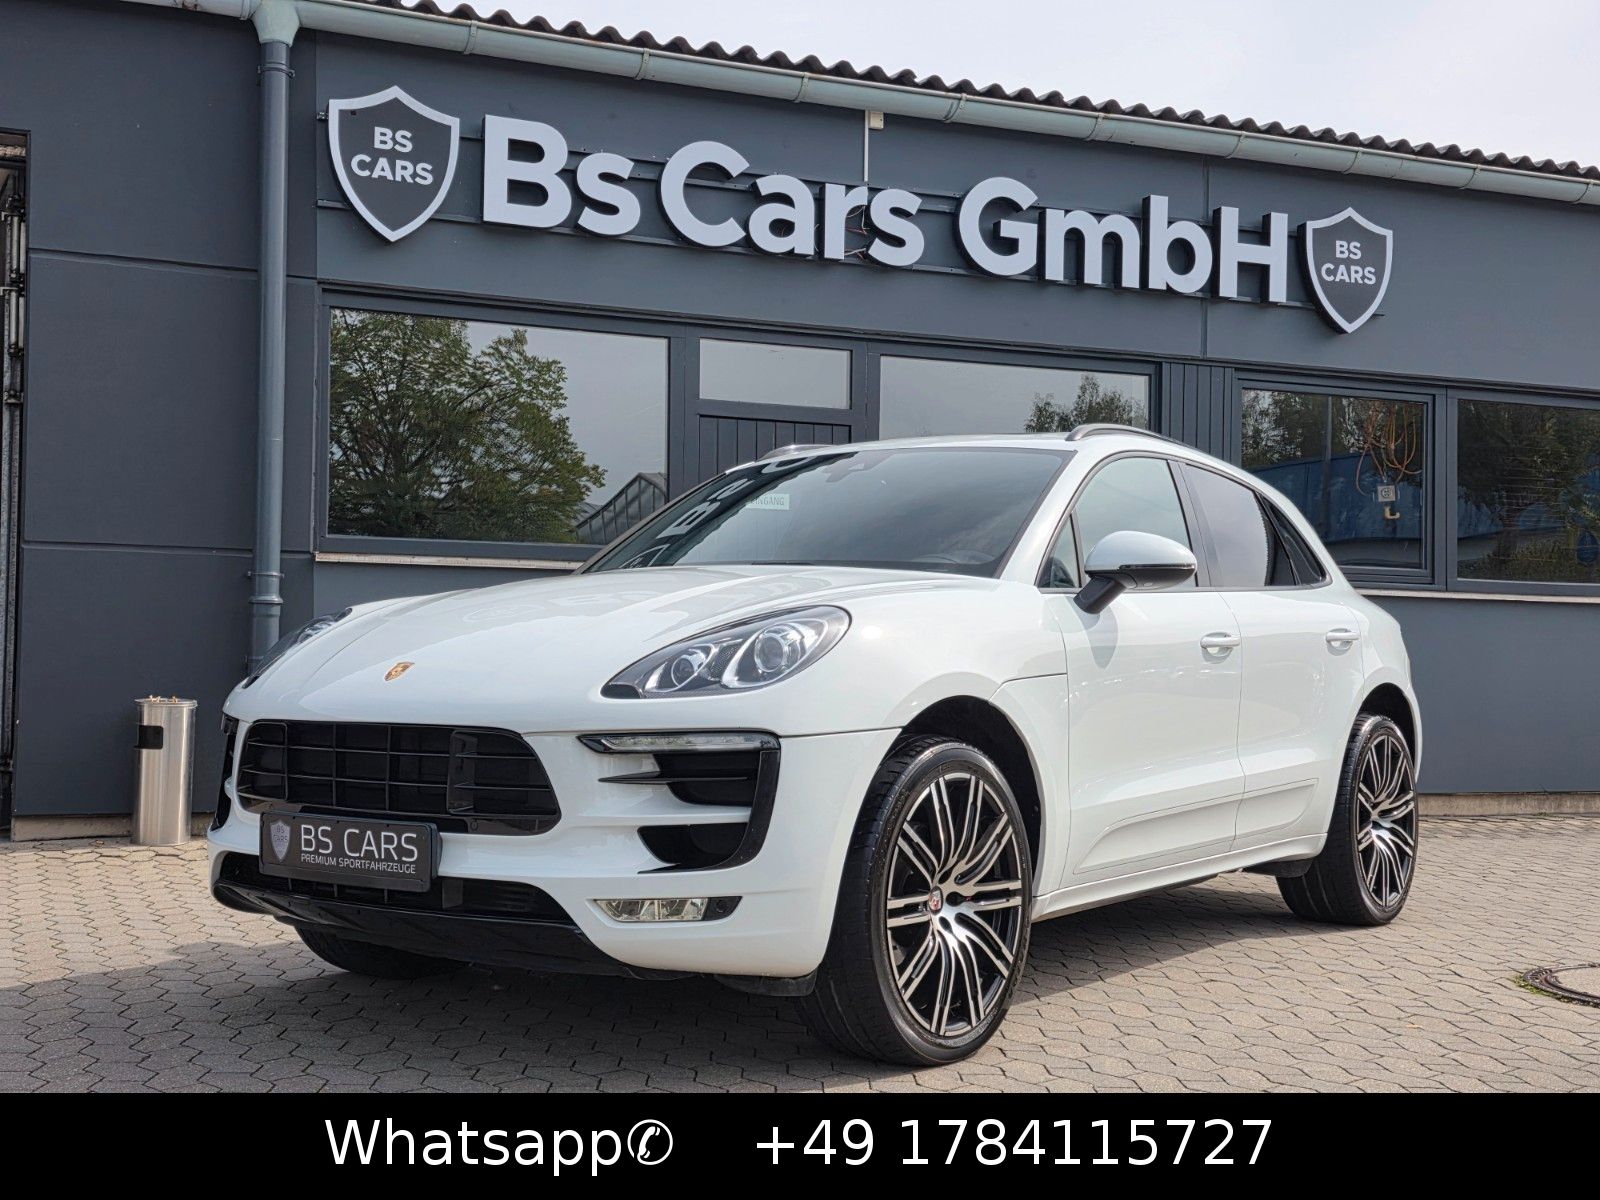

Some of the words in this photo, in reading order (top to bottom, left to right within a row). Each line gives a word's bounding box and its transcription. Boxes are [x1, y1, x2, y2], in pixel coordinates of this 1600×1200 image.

[373, 127, 413, 153] BS
[351, 154, 434, 186] CARS
[483, 114, 641, 235] Bs
[660, 140, 926, 267] Cars
[958, 176, 1289, 303] GmbH
[1335, 240, 1362, 260] BS
[1320, 262, 1376, 285] CARS
[301, 824, 333, 854] BS
[343, 828, 418, 862] CARS
[301, 853, 337, 866] PREMIUM
[338, 857, 416, 874] SPORTFAHRZEUGE
